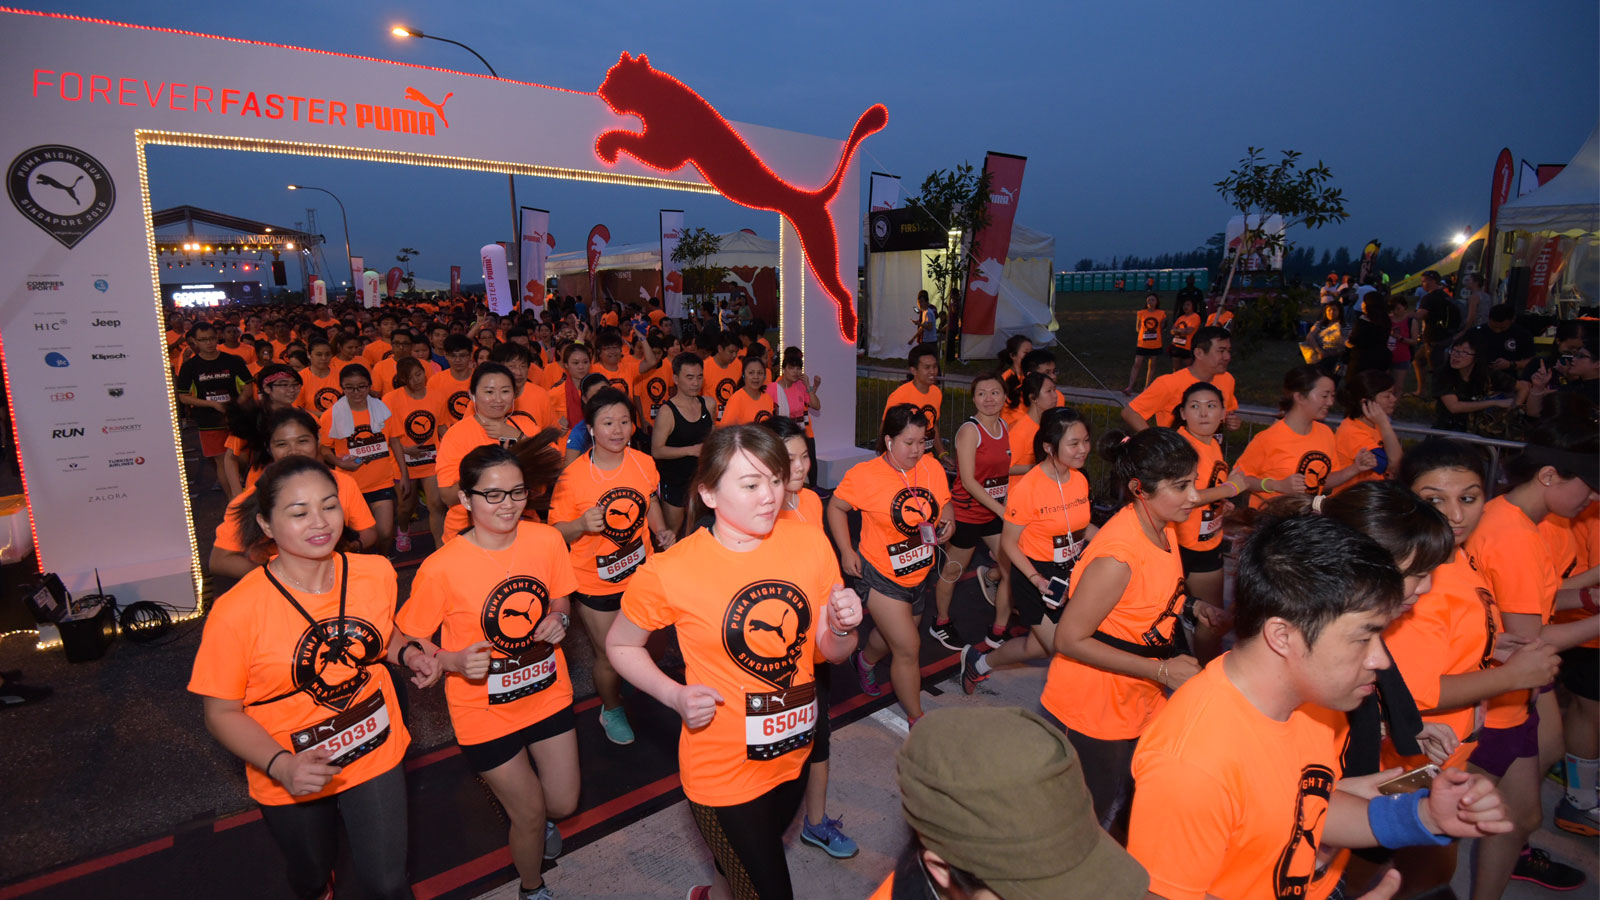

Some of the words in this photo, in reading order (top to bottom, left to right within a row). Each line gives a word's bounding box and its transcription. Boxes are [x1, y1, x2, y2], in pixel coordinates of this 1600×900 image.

[355, 103, 437, 137] PUMA
[17, 155, 41, 178] PUMA
[43, 151, 81, 163] NIGHT
[83, 161, 103, 181] RUN
[20, 198, 84, 227] SINGAPORE
[485, 258, 494, 280] PUMA
[488, 281, 499, 312] FASTER
[92, 318, 121, 328] Jeep
[92, 352, 126, 360] Klipsch
[52, 427, 85, 439] RUN
[88, 492, 128, 503] ZALORA
[606, 551, 640, 575] 66685
[898, 544, 930, 565] 65477
[488, 593, 503, 618] PUMA
[503, 581, 529, 593] NIGHT
[532, 584, 546, 598] RUN
[731, 600, 749, 629] PUMA
[749, 587, 783, 600] NIGHT
[786, 590, 804, 610] RUN
[354, 626, 374, 642] RUN
[738, 652, 795, 672] SINGAPORE
[501, 660, 550, 688] 65036
[311, 680, 357, 698] NGAPORE
[762, 705, 815, 737] 65041
